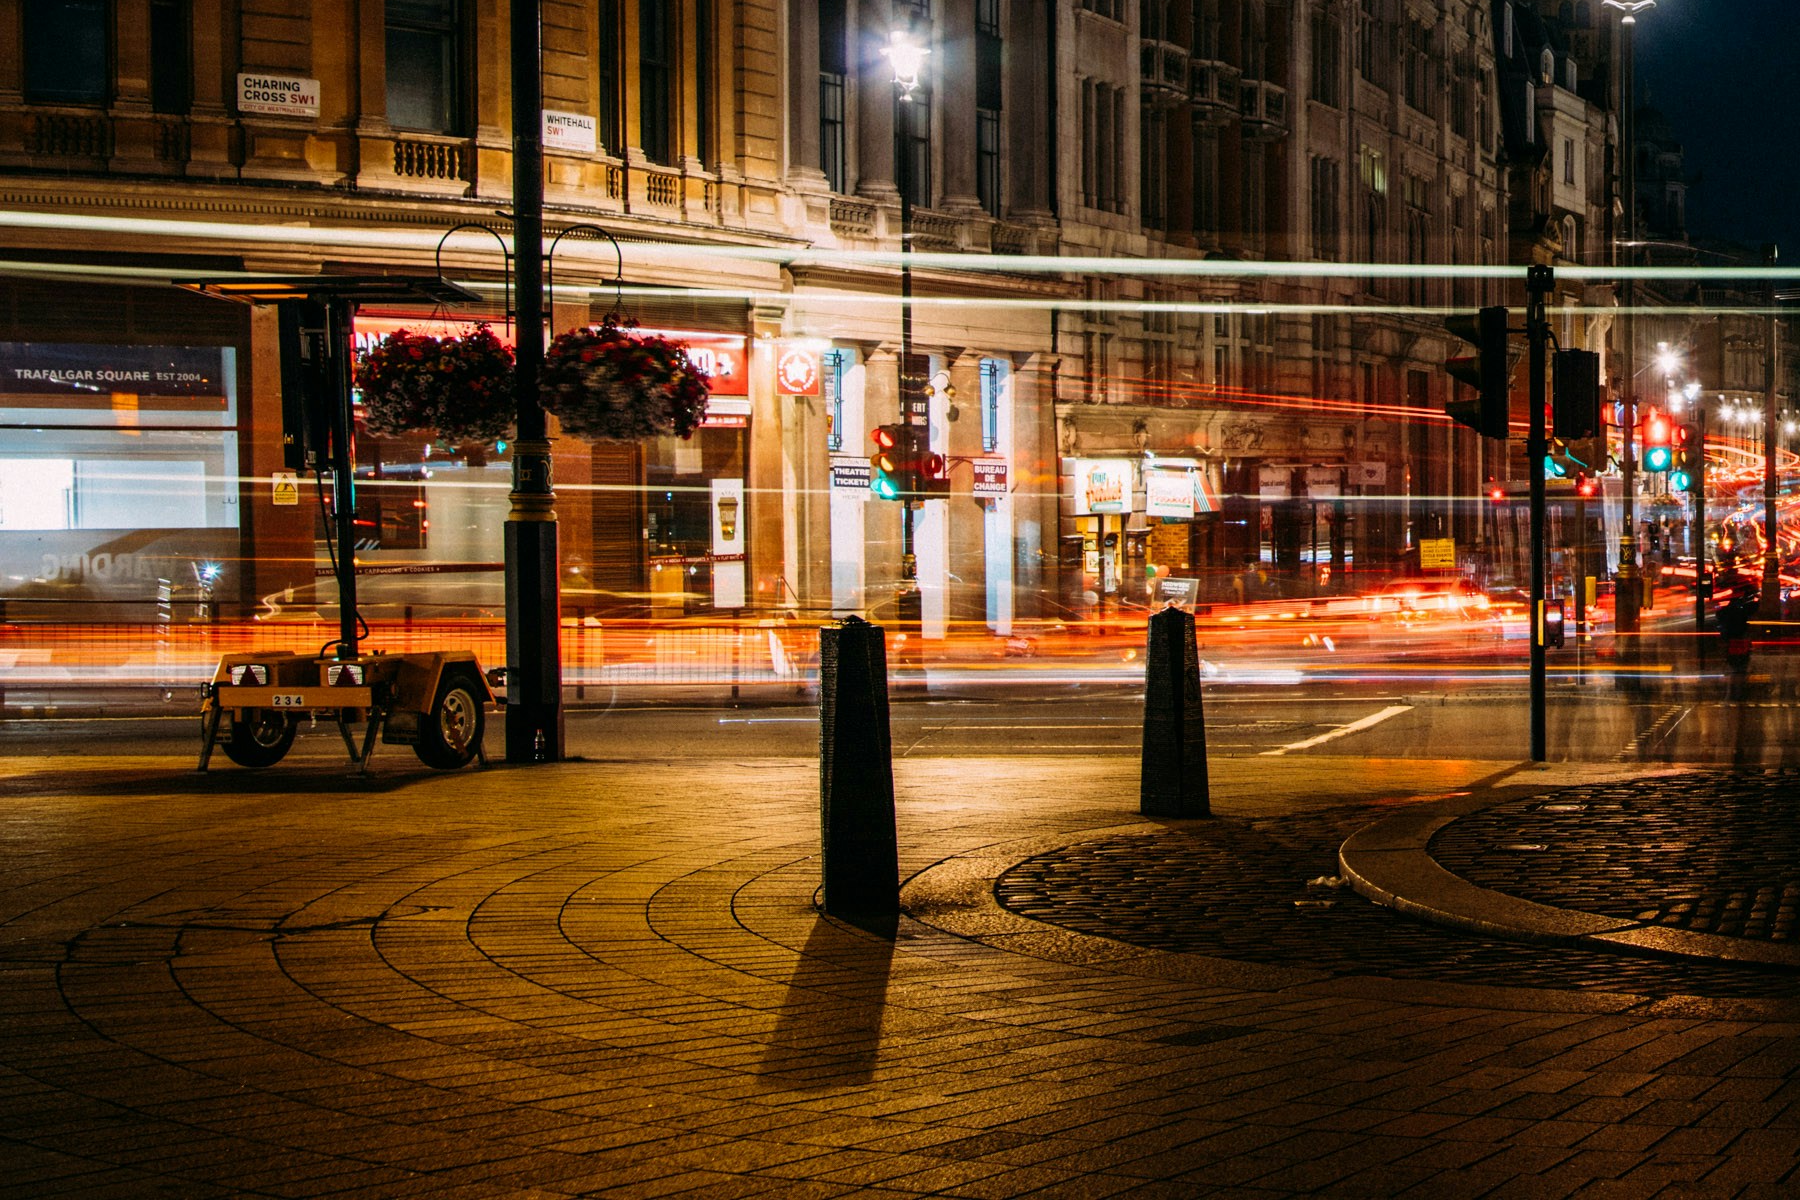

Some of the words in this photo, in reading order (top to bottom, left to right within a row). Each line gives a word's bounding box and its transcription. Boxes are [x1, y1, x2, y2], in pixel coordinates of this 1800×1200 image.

[244, 78, 300, 92] CHARING
[244, 90, 287, 103] CROSS
[290, 93, 315, 105] SW1
[546, 114, 592, 130] WHITEHALL
[547, 125, 564, 136] SW1
[15, 368, 94, 381] TRAFALGAR
[95, 370, 150, 382] SQUARE
[156, 372, 175, 381] EST
[177, 372, 202, 382] 2004
[835, 467, 870, 476] THEATRE
[974, 465, 1006, 475] BUREAU
[835, 477, 869, 486] TICKETS
[984, 474, 996, 483] DE
[974, 482, 1006, 491] CHANGE
[364, 566, 402, 575] CAPPUCCINO
